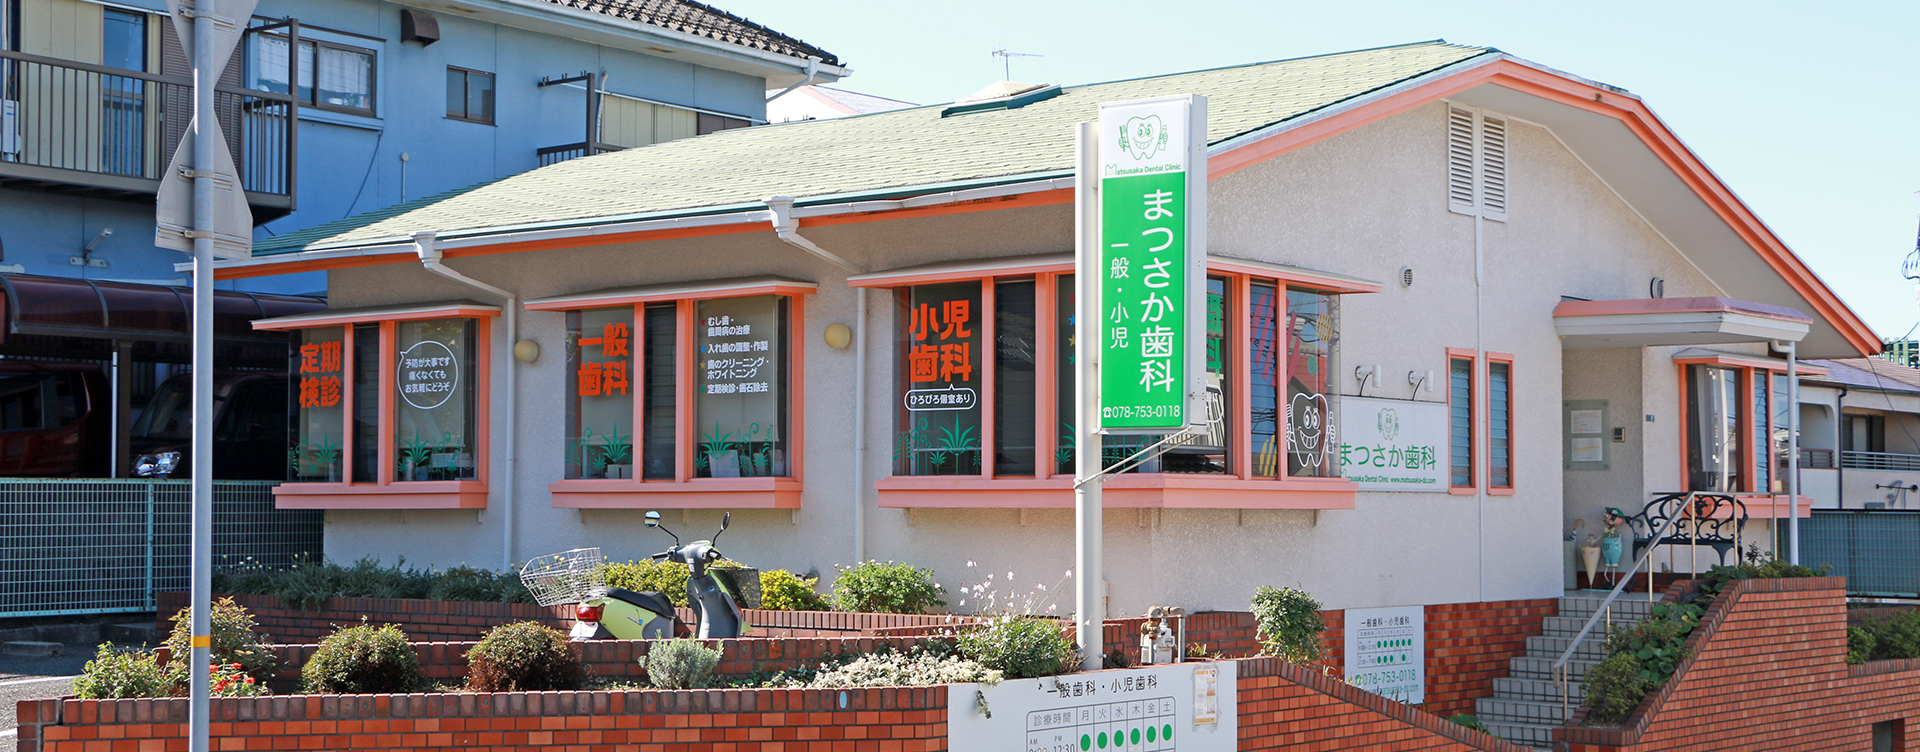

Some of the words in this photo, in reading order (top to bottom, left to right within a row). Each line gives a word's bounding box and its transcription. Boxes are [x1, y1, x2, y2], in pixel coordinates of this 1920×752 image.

[1144, 165, 1164, 173] Dental
[1165, 163, 1181, 171] Clinic
[1110, 243, 1129, 349] 一般・小児
[1140, 189, 1174, 393] まつさか歯科
[708, 325, 750, 337] 歯周病の治療
[909, 299, 971, 341] 小児
[578, 322, 629, 358] 一般
[300, 341, 341, 374] 定期
[405, 357, 450, 369] 予防が大事です
[909, 342, 972, 383] 歯科
[408, 370, 447, 380] 痛くなくても
[577, 360, 629, 396] 歯科
[707, 367, 757, 380] ホワイトニング
[299, 375, 341, 408] 検診
[405, 382, 450, 393] お気軽にどうぞ
[707, 382, 768, 394] 定期検診・歯石除去
[910, 394, 970, 405] ひろびろ個室あり
[1112, 405, 1180, 418] 078-753-0118
[1341, 442, 1436, 470] まつさか歯科
[1047, 674, 1158, 698] 一般歯科・小児歯科
[1363, 669, 1416, 686] 078-753-0118
[1034, 712, 1071, 727] 診療時間
[1082, 710, 1089, 721] 月
[1099, 708, 1107, 719] 火
[1115, 706, 1123, 717] 水
[1132, 704, 1140, 715] 木
[1148, 703, 1155, 714] 金
[1163, 701, 1171, 712] 土
